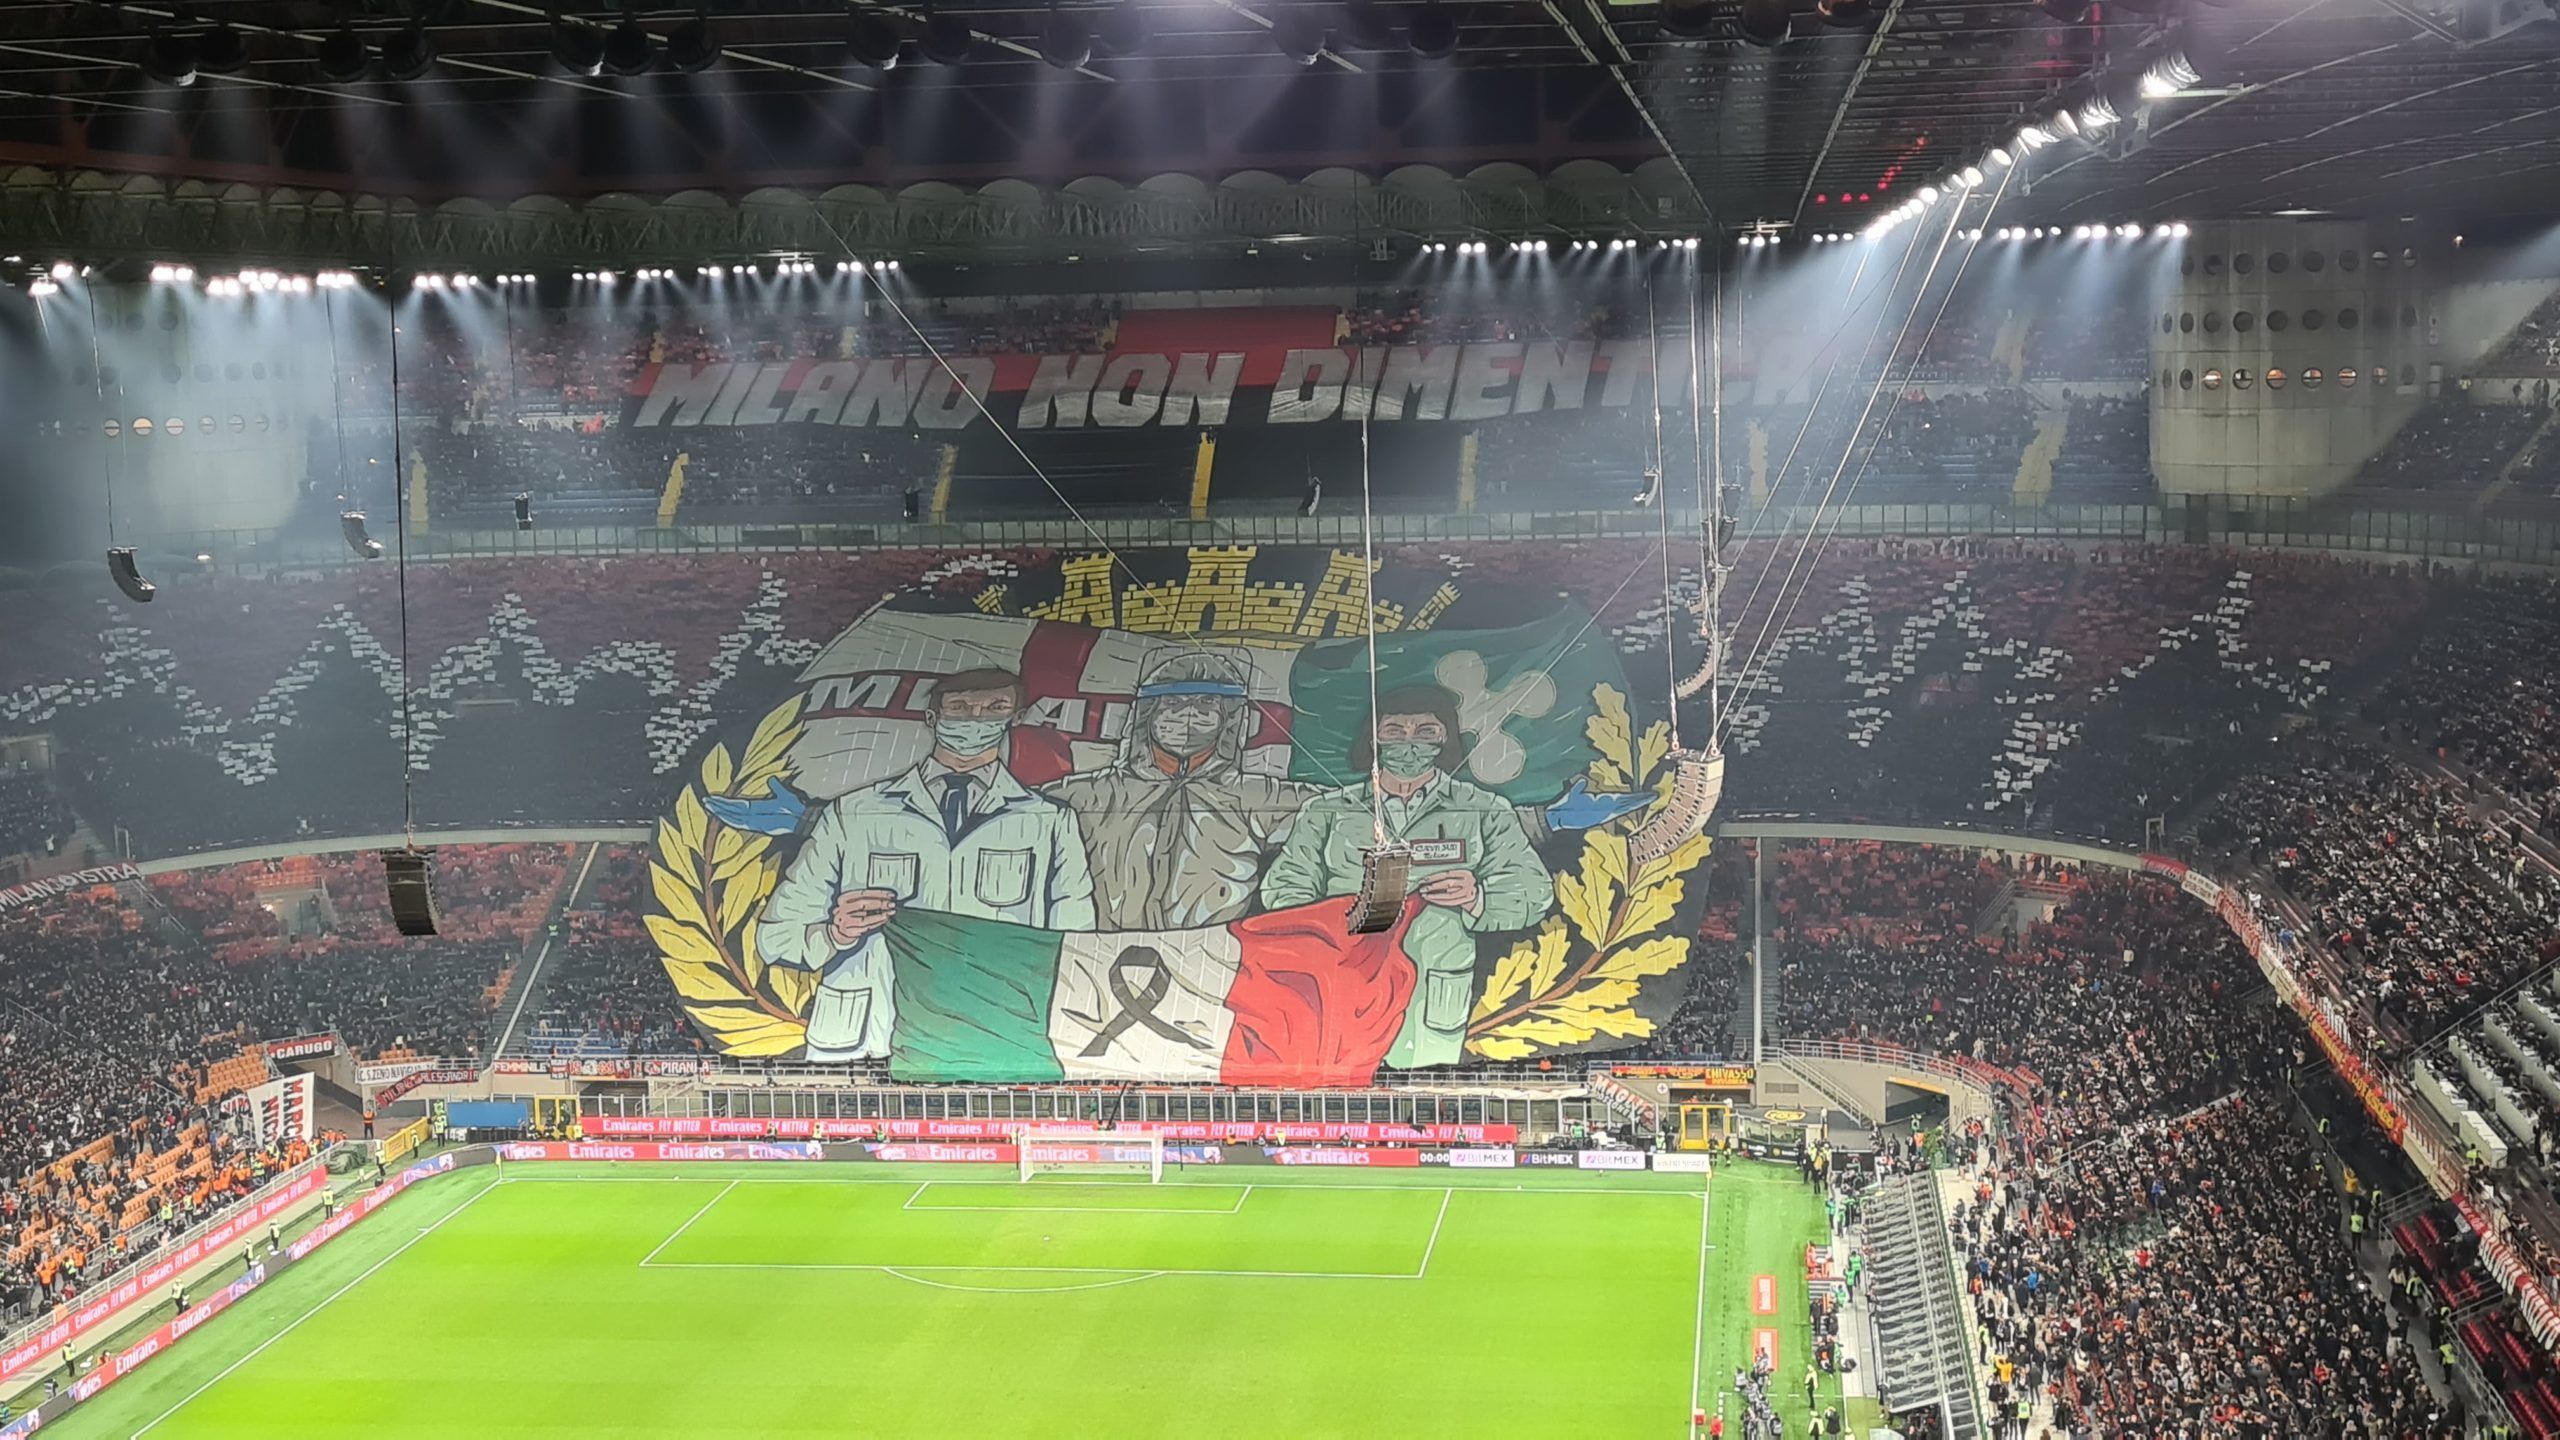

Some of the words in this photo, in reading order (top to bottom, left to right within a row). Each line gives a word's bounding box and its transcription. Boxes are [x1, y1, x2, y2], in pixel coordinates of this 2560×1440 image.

[633, 356, 999, 429] MILANO
[1017, 352, 1246, 429] NON
[72, 862, 140, 884] ISTRA
[276, 1040, 333, 1060] CARUGO
[1706, 1067, 1754, 1080] CHIVASSO
[603, 1120, 654, 1132] Emirates
[673, 1120, 700, 1132] BETTER
[711, 1120, 762, 1133] Emirates
[821, 1121, 873, 1134] Emirates
[930, 1122, 982, 1135] Emirates
[1040, 1123, 1093, 1135] Emirates
[1153, 1125, 1206, 1136] Emirates
[1266, 1125, 1320, 1137] Emirates
[1380, 1126, 1434, 1138] Emirates
[568, 1143, 634, 1159] Emirates
[659, 1143, 725, 1160] Emirates
[930, 1145, 997, 1161] Emirates
[1023, 1146, 1089, 1162] Emirates
[1300, 1149, 1370, 1164] Emirates
[1420, 1153, 1450, 1163] 00:00
[1531, 1154, 1574, 1165] BitMEX
[204, 1226, 233, 1250] Emirates
[142, 1263, 174, 1288] Emirates
[75, 1304, 109, 1329] Emirates
[172, 1303, 211, 1339] Emirates
[2, 1345, 39, 1374] Emirates
[115, 1338, 158, 1375] Emirates
